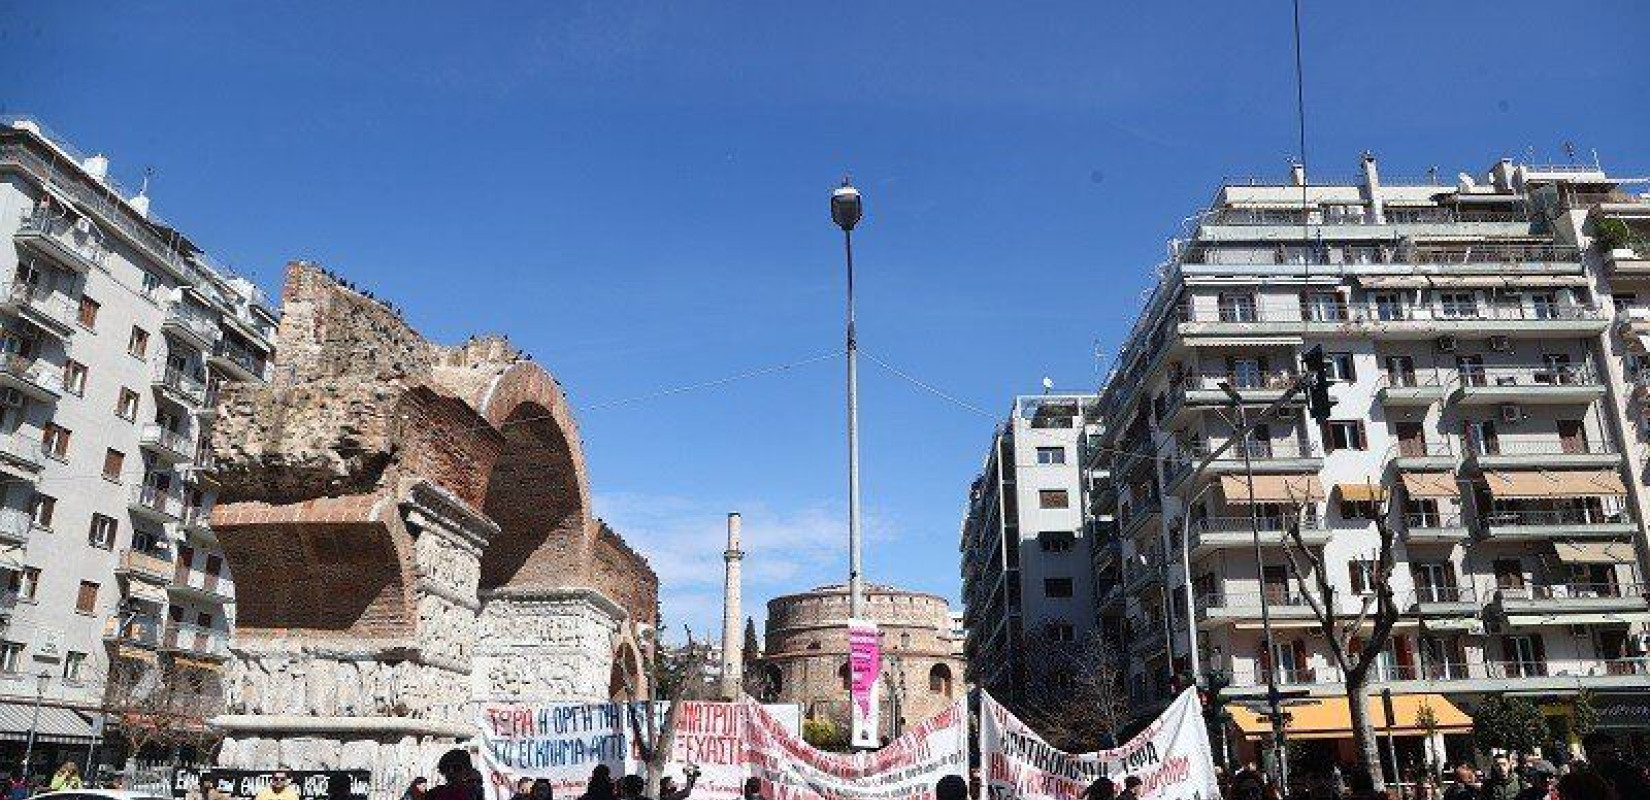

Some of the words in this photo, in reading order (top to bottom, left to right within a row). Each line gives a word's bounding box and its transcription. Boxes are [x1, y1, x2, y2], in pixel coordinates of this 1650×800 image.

[487, 708, 535, 737] ΤΩΡΑ
[538, 708, 548, 736] Η
[554, 704, 593, 735] ΟΡΓΗ
